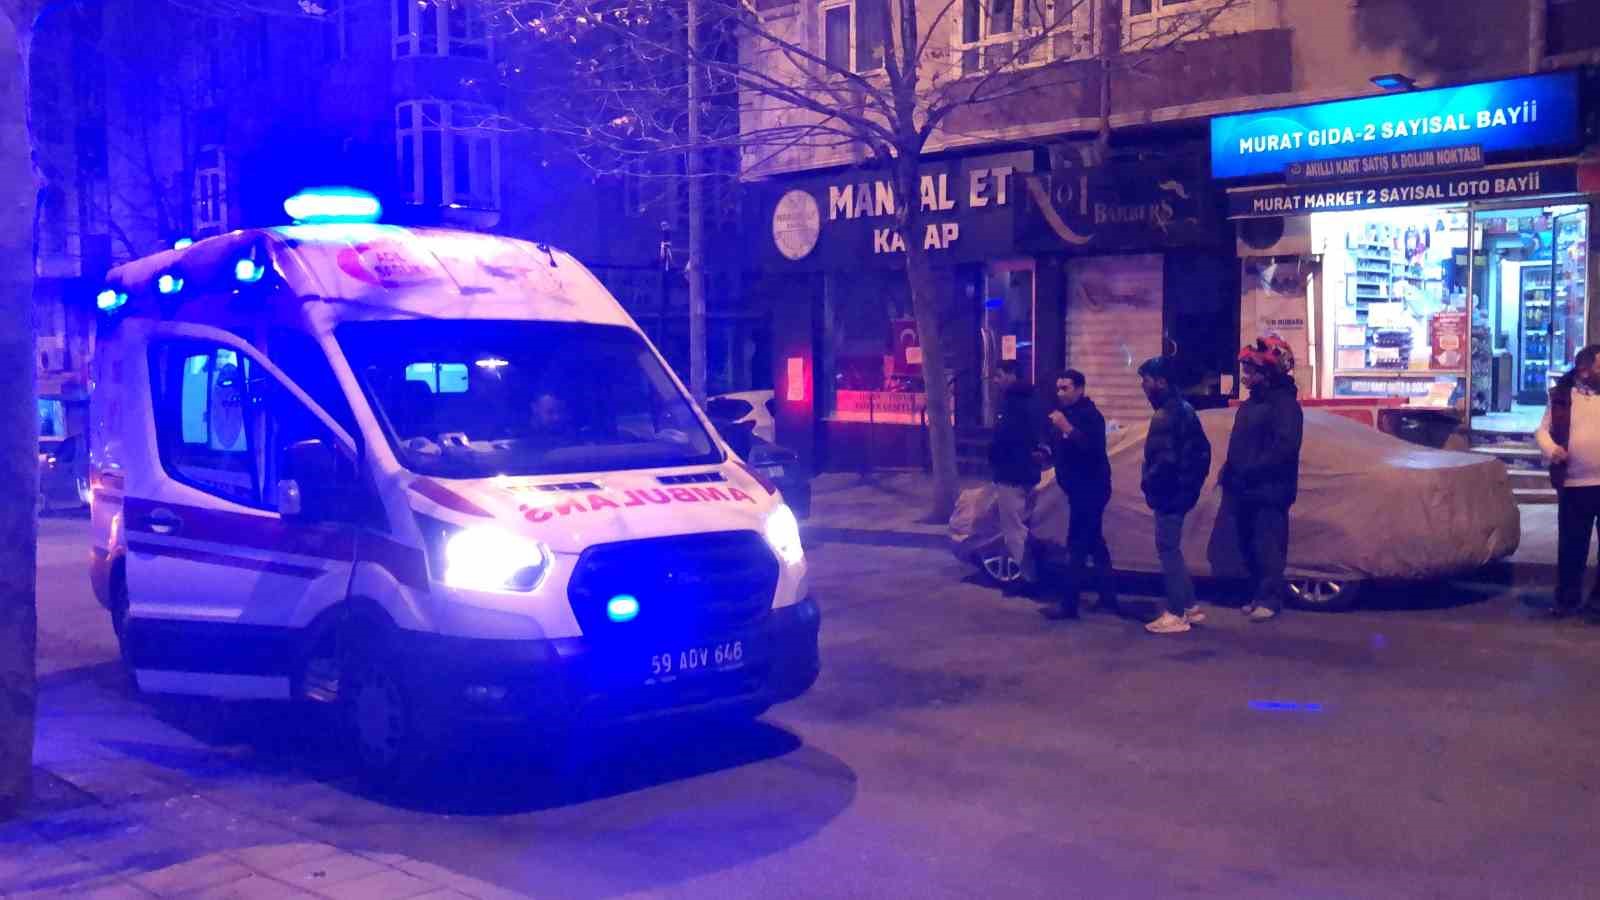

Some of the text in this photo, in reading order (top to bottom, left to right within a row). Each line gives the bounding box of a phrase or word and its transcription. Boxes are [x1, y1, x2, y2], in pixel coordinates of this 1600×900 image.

[1239, 132, 1302, 155] MURAT
[1307, 122, 1377, 147] GIDA-2
[1381, 112, 1471, 140] SAYISAL
[1336, 157, 1361, 175] KART
[1436, 145, 1481, 165] NOKTASI
[829, 166, 1013, 221] MANAL ET
[1253, 196, 1301, 213] MURAT
[1304, 190, 1363, 209] MARKET
[1367, 190, 1376, 204] 2
[1380, 184, 1445, 204] SAYISAL
[1449, 178, 1490, 197] LOTO
[873, 222, 959, 254] KAAP
[651, 640, 743, 675] 59 ADV 646
